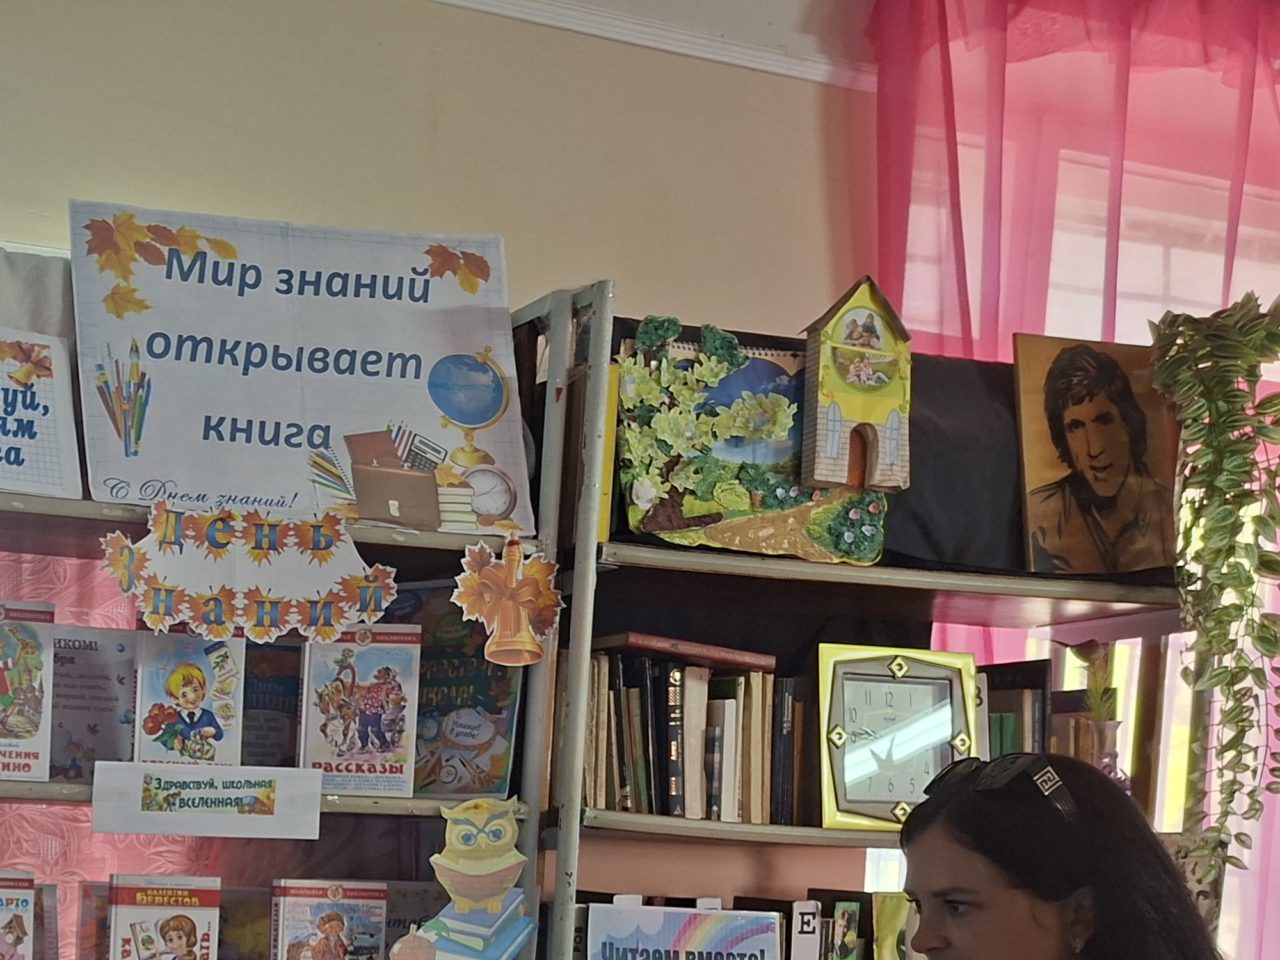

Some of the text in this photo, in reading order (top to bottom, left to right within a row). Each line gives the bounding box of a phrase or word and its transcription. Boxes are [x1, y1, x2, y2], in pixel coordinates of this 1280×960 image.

[165, 247, 431, 304] Мир знаний
[145, 331, 423, 380] открывает
[202, 414, 332, 452] книга
[103, 477, 131, 500] С
[216, 491, 300, 511] знаний!
[864, 690, 872, 706] 11
[885, 692, 894, 708] 12
[849, 707, 858, 724] 10
[888, 778, 894, 793] 6
[910, 777, 916, 794] 5
[797, 911, 817, 935] Е
